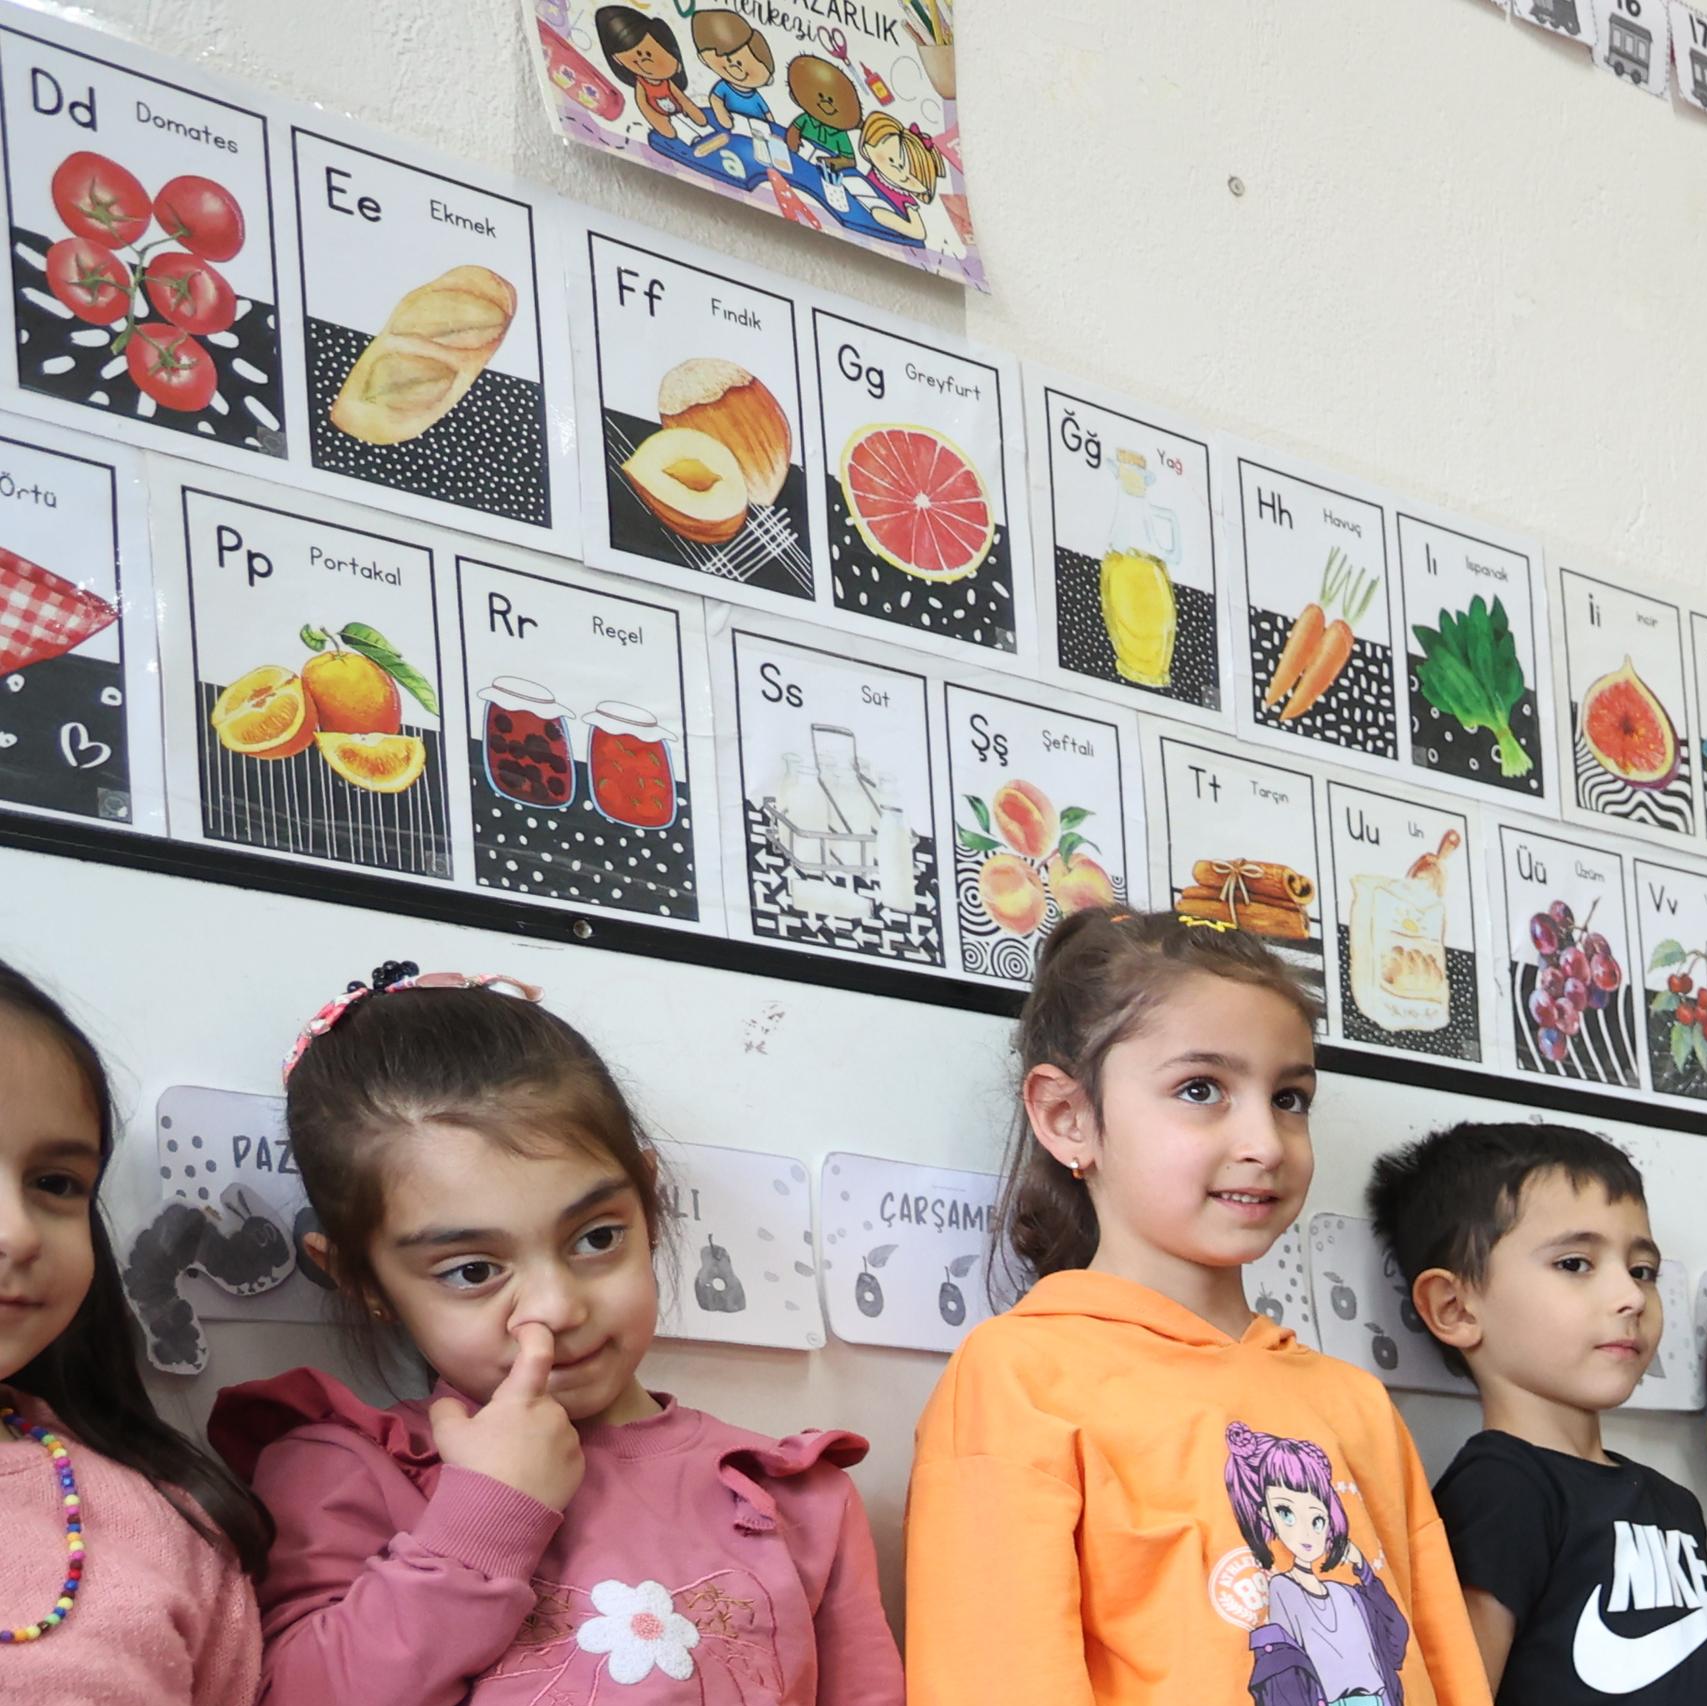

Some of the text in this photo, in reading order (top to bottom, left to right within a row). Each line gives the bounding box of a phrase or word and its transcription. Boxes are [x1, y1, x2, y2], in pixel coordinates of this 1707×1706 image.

[720, 0, 817, 43] erkezi
[31, 68, 239, 154] Dd Domates
[325, 166, 498, 239] Ee Ekmek
[616, 265, 762, 331] Ff Fındık
[837, 343, 982, 402] Gg Greyfurt
[1060, 408, 1184, 476] Ğğ Yağ
[1257, 486, 1362, 539] Hh Havuç
[216, 525, 402, 587] Pp Portakal
[1465, 555, 1509, 583] Ispanak
[488, 592, 644, 646] Rr Reçel
[760, 663, 804, 708] Ss
[969, 713, 1095, 767] Şş Şeftali
[1188, 764, 1290, 806] Tt Tarçın
[1346, 805, 1425, 847] Uu Un
[1516, 844, 1548, 886] Üü
[1648, 881, 1679, 916] Vv
